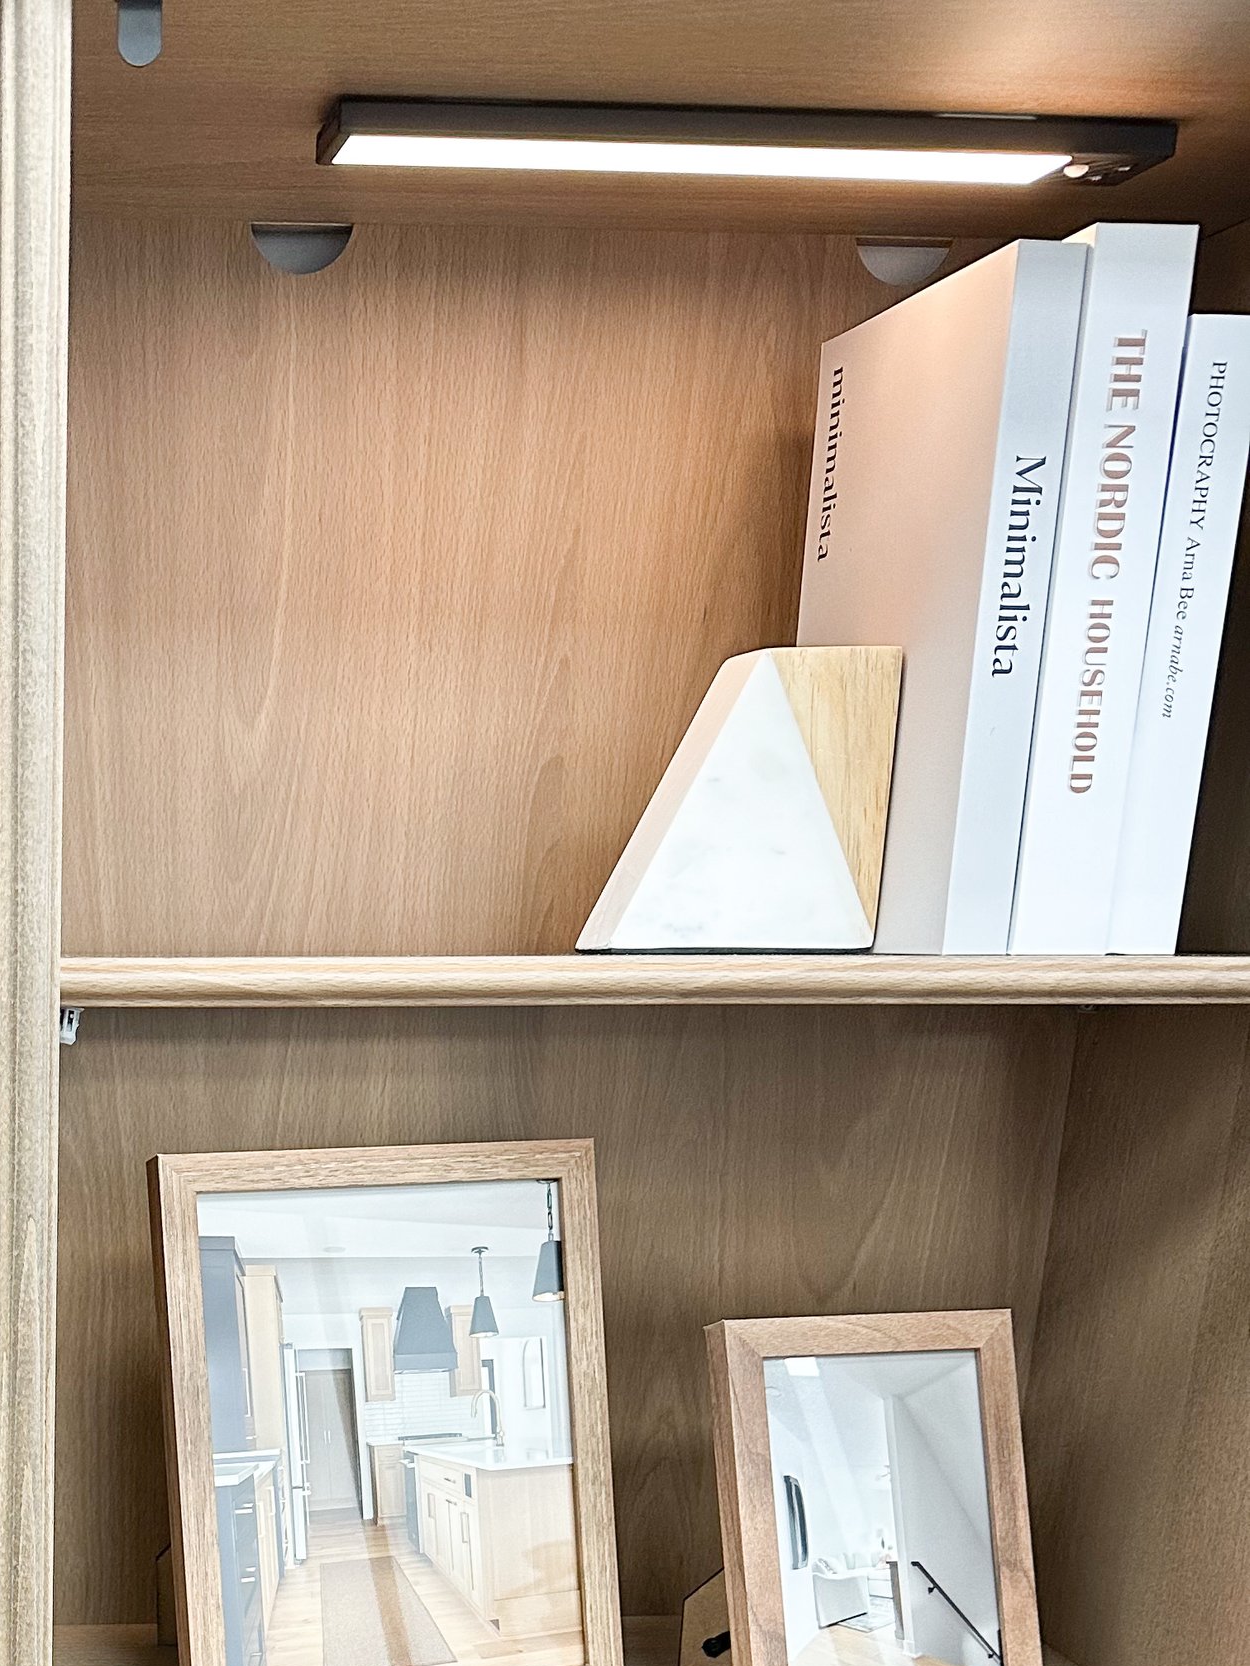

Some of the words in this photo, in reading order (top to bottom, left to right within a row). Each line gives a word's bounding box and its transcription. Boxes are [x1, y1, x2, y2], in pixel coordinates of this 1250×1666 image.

[1106, 329, 1148, 411] THE
[817, 366, 846, 563] minimalista
[1088, 424, 1137, 580] NORDIC
[990, 454, 1048, 679] Minimalista
[1176, 587, 1195, 621] Bee
[1181, 536, 1202, 581] Arna
[1068, 600, 1115, 794] HOUSEHOLD
[1162, 624, 1184, 718] arnabe.com
